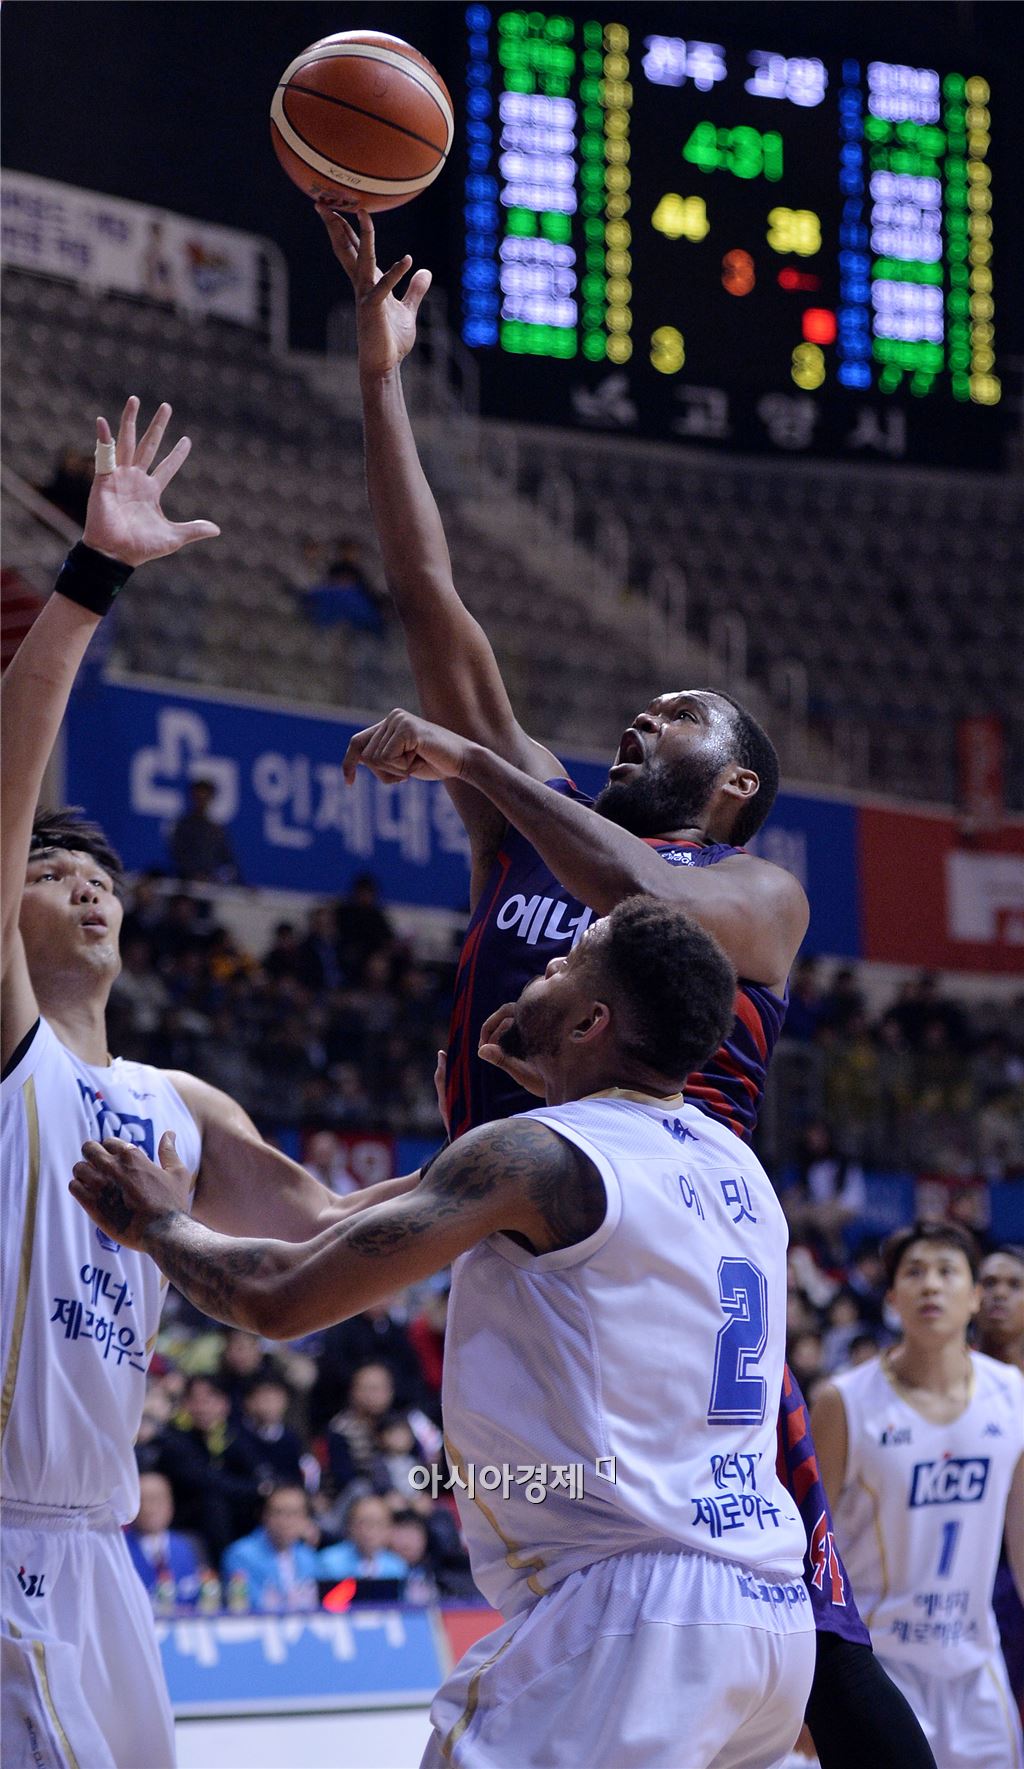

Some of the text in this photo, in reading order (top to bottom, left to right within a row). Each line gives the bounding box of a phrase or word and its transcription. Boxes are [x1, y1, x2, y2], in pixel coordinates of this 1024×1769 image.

[707, 1255, 769, 1426] 2
[909, 1458, 990, 1508] KCC
[936, 1519, 960, 1578] 1
